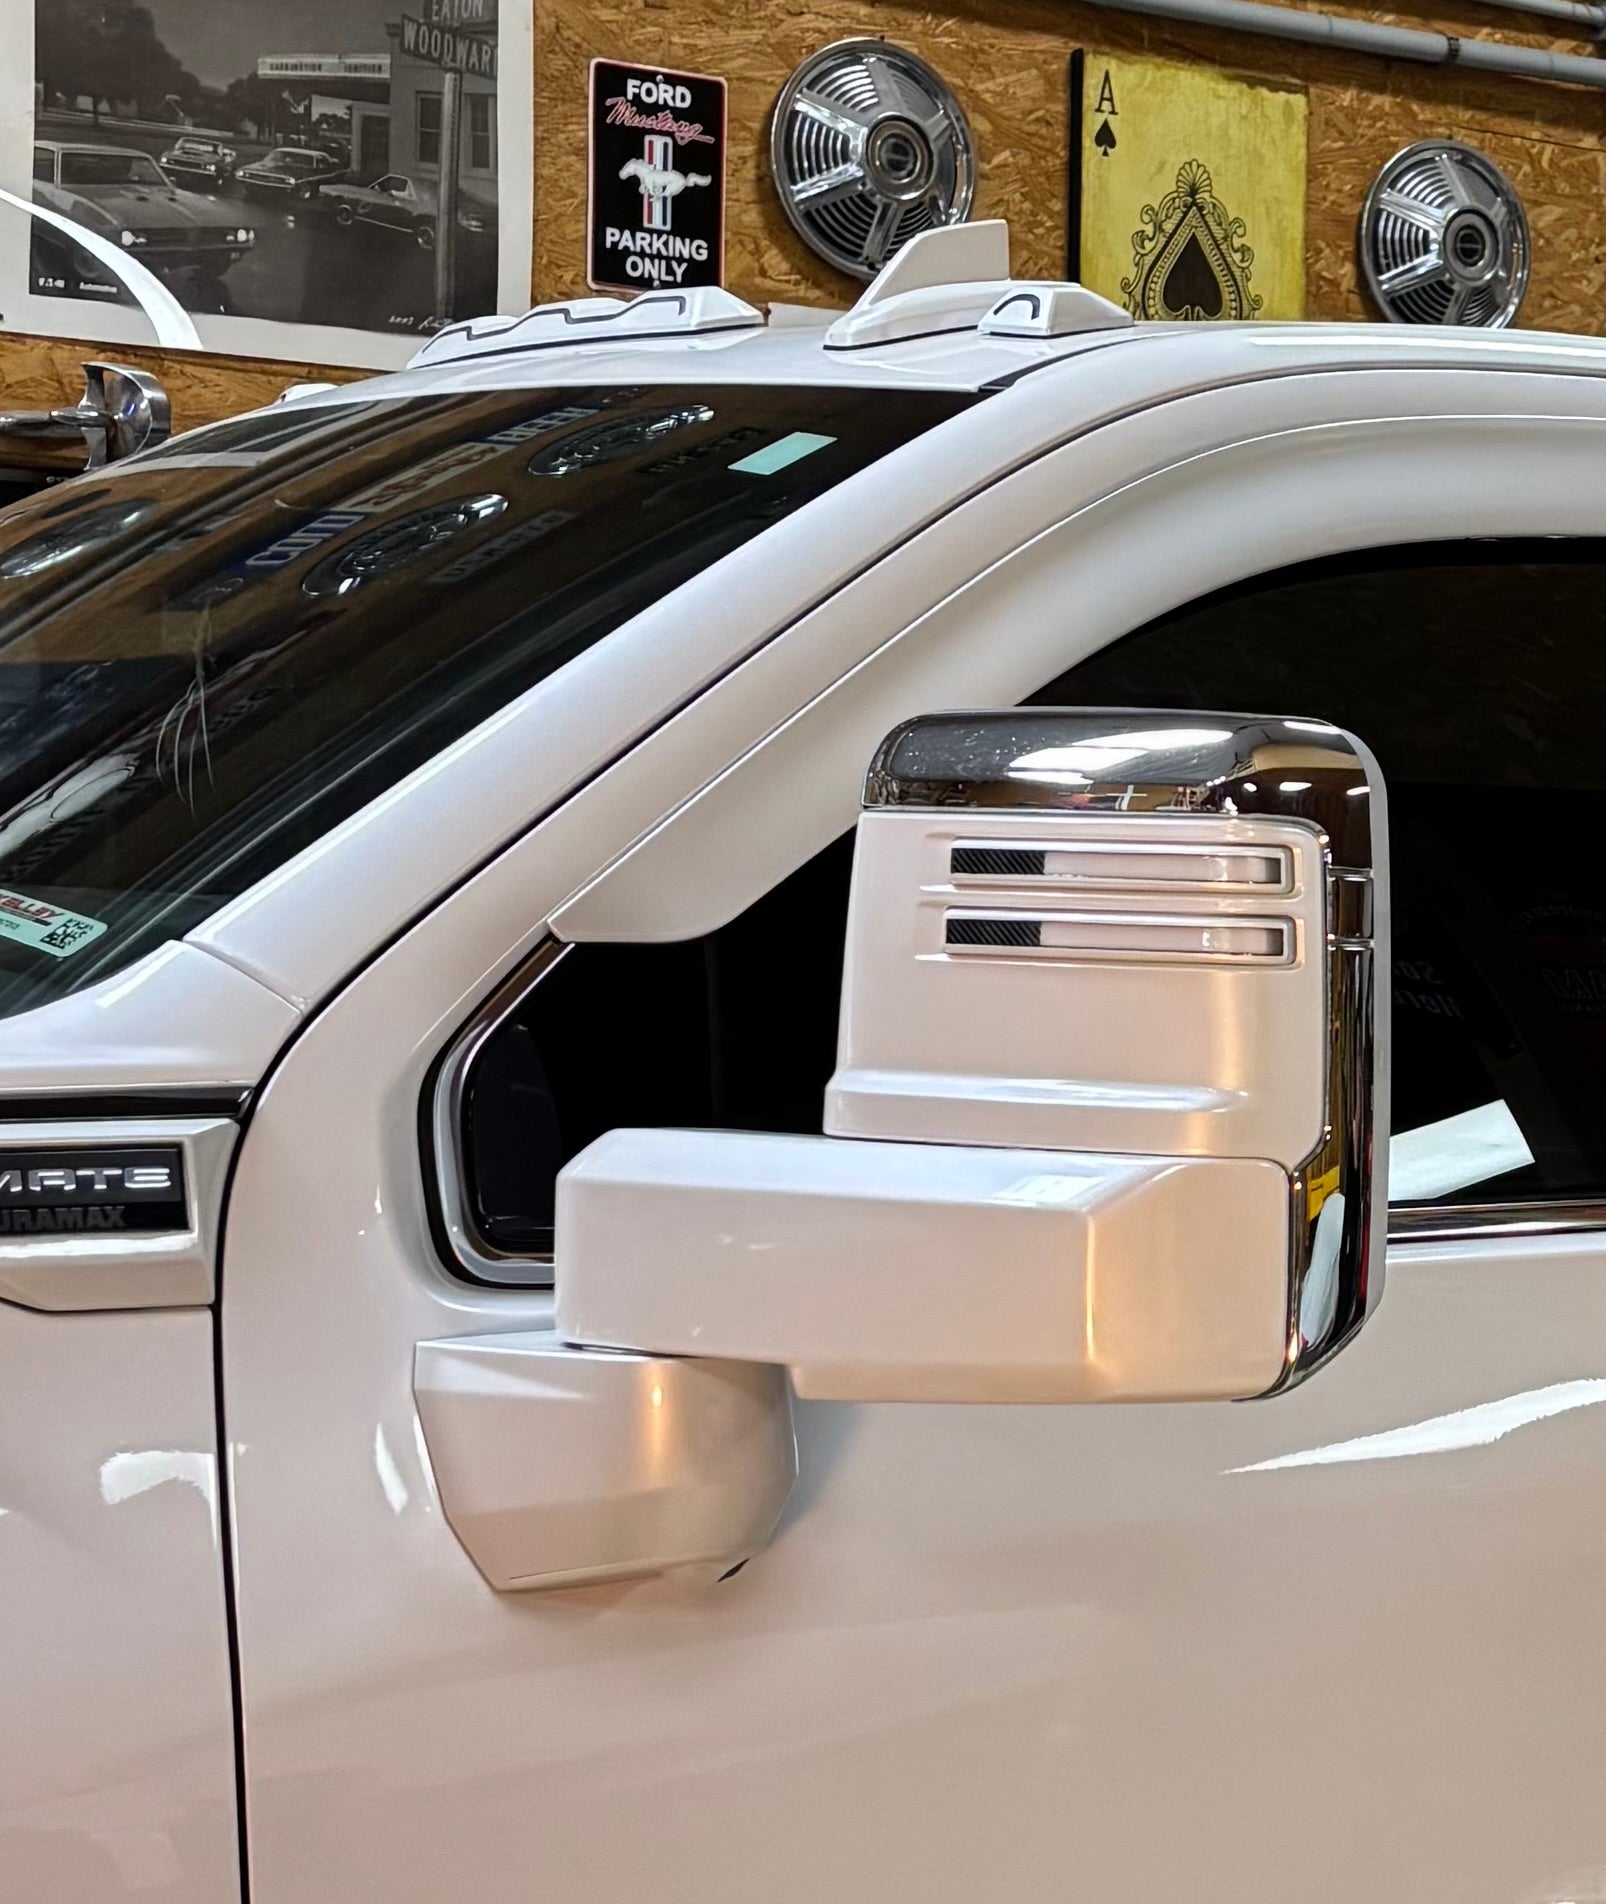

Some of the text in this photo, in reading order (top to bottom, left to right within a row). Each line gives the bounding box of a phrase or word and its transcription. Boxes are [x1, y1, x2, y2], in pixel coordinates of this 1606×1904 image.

[627, 78, 692, 109] FORD
[1094, 69, 1119, 116] A
[605, 96, 715, 145] Mustang
[605, 227, 708, 261] PARKING
[625, 256, 688, 284] ONLY
